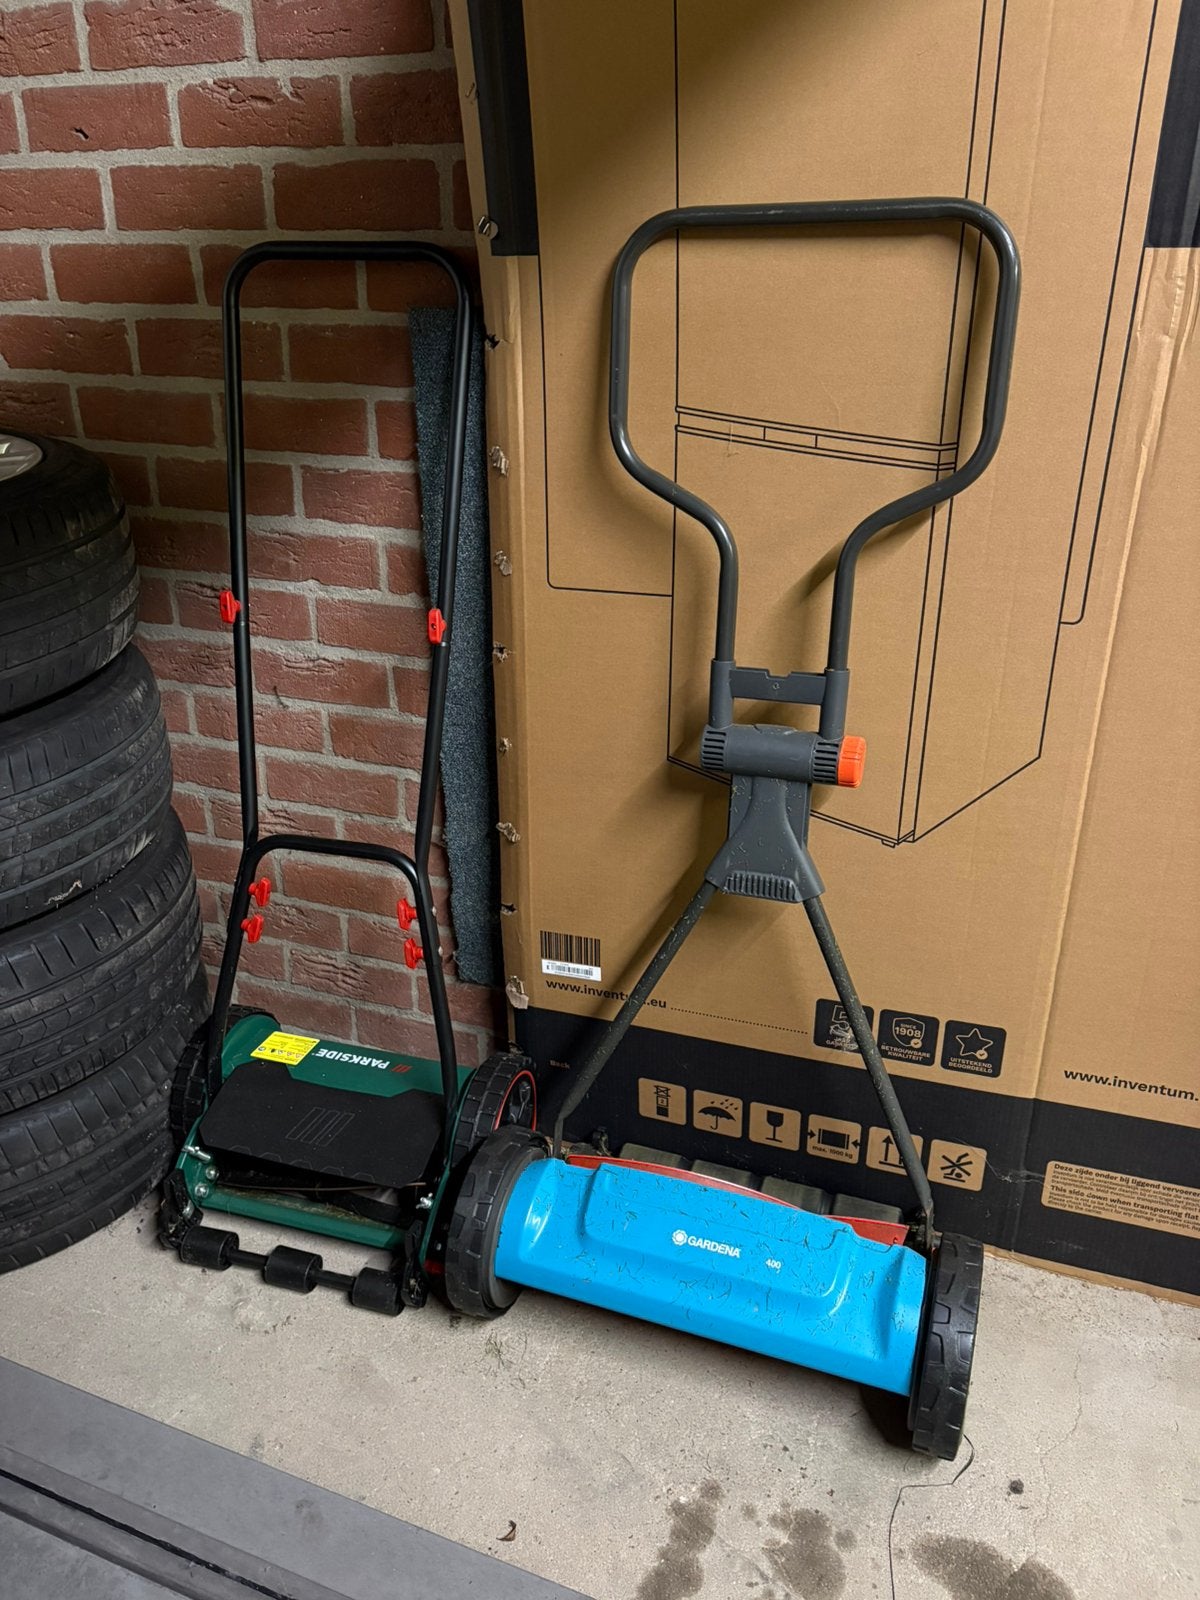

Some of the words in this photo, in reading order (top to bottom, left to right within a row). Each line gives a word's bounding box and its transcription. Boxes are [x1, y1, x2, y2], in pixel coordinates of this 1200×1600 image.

[546, 980, 667, 1008] www.invent.eu
[895, 1026, 921, 1038] 1908
[315, 1048, 390, 1069] PARKSIDE
[950, 1057, 992, 1068] UITSTEKEND
[1064, 1070, 1199, 1101] www.inventum.
[1054, 1164, 1073, 1172] Deze
[1075, 1168, 1093, 1176] zijde
[1095, 1172, 1118, 1180] onder
[1131, 1179, 1160, 1189] liggend
[1133, 1202, 1182, 1217] transporting
[688, 1236, 740, 1258] GARDENA
[766, 1258, 782, 1269] 400
